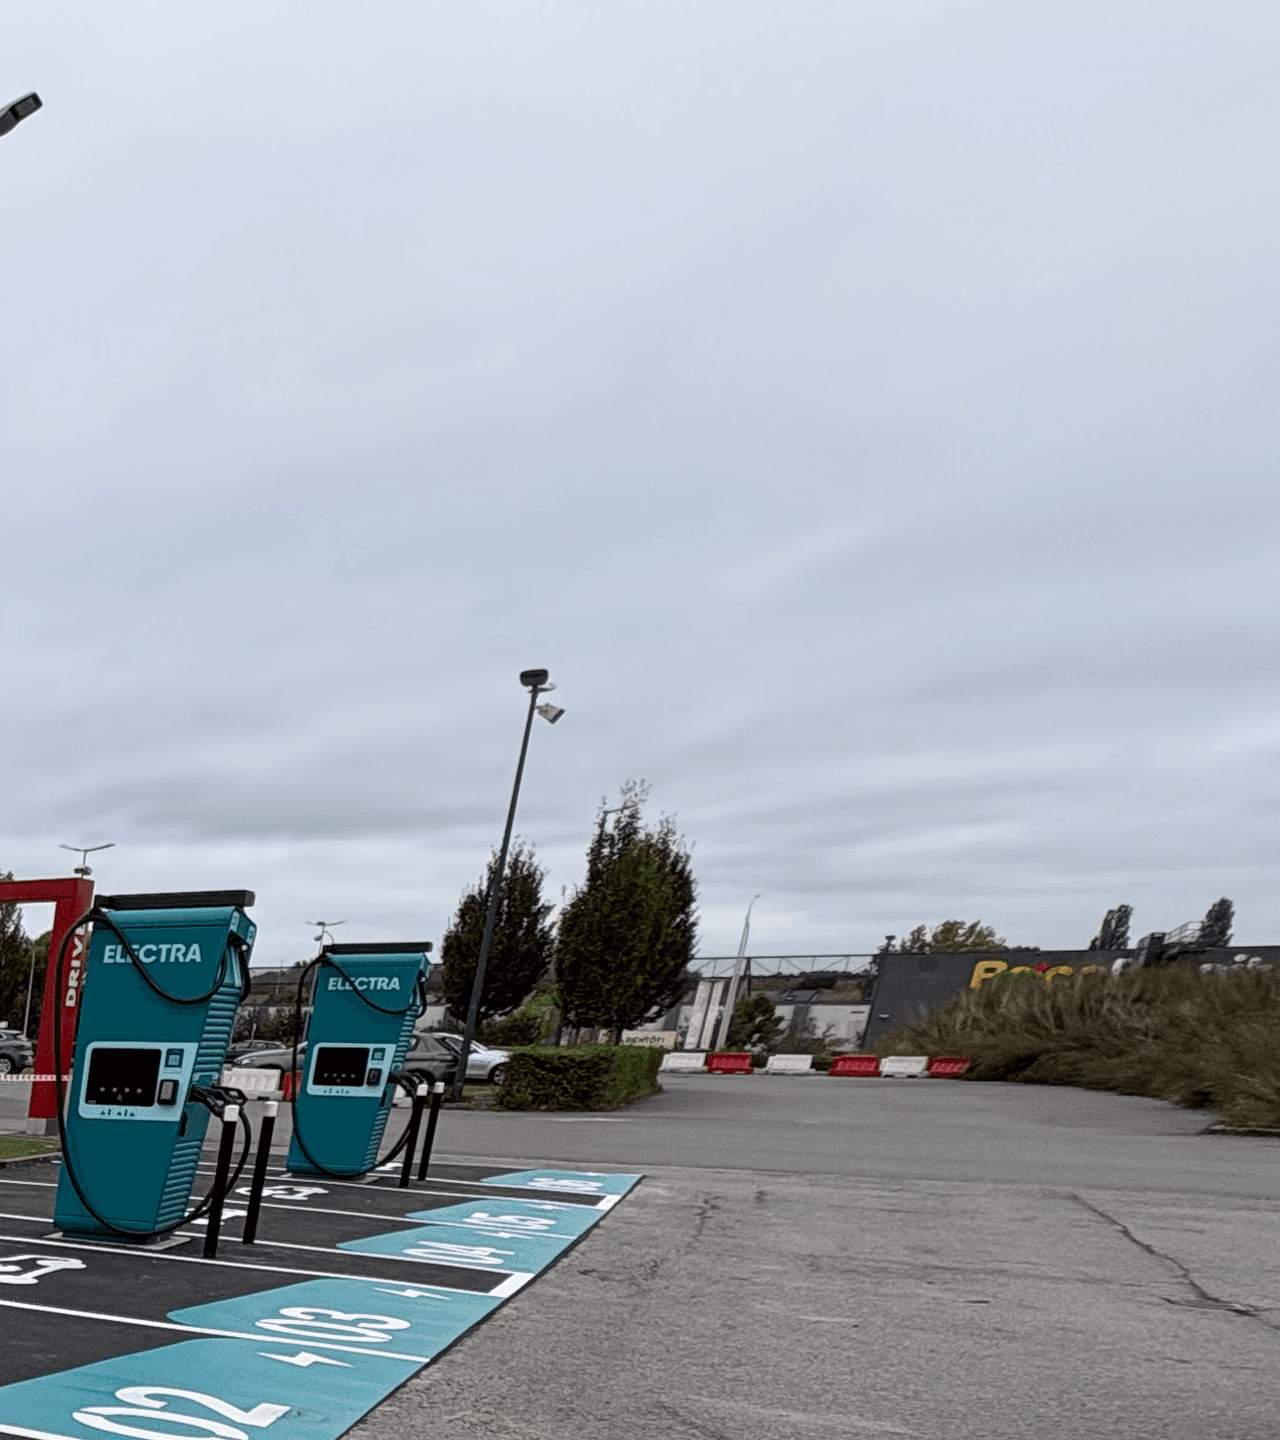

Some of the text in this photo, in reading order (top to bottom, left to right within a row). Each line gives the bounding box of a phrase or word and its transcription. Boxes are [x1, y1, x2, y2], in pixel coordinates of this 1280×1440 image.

[462, 1212, 557, 1231] 05
[402, 1241, 516, 1265] 04
[254, 1306, 411, 1343] 03
